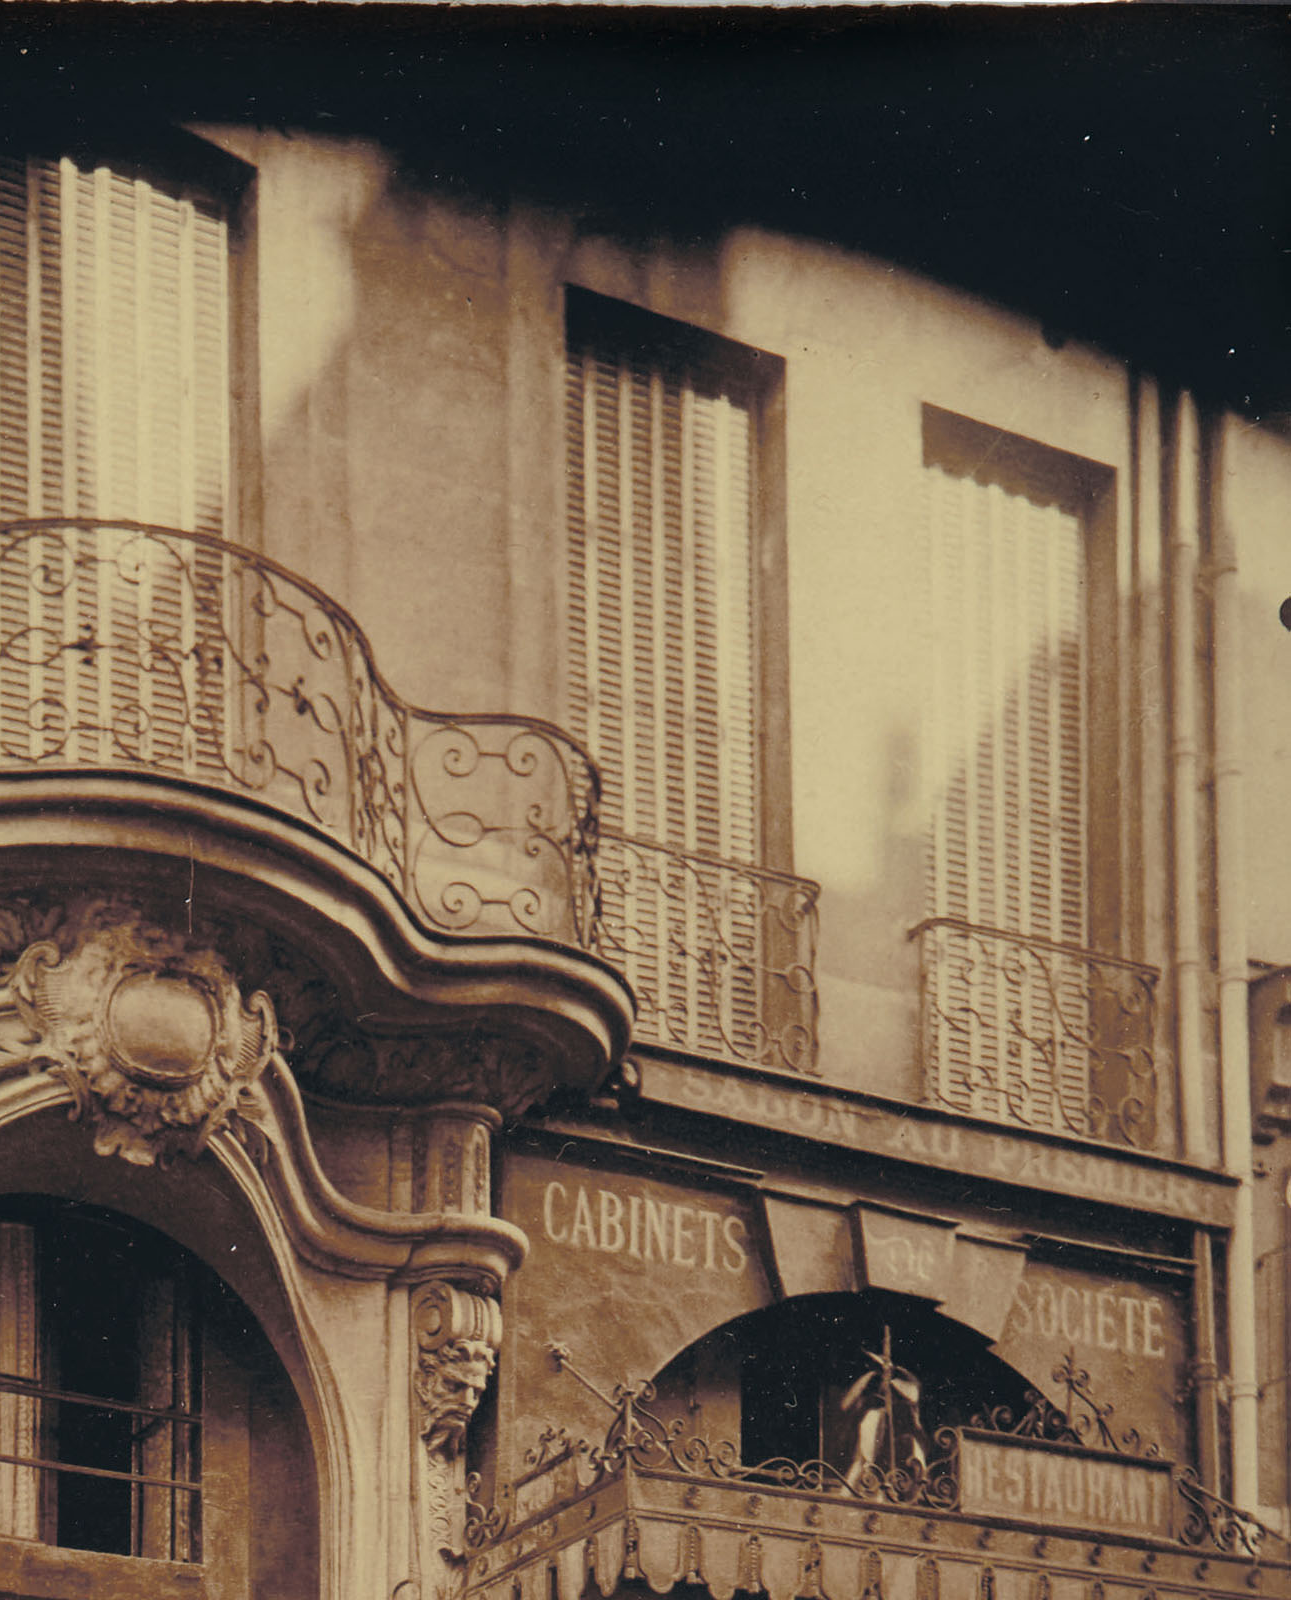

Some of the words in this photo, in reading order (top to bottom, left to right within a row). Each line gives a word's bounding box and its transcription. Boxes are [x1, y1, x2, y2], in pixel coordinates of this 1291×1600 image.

[682, 1074, 860, 1144] SALON
[886, 1117, 961, 1160] AU
[989, 1135, 1200, 1214] PREMIER
[543, 1180, 747, 1275] CABINETS
[1009, 1277, 1167, 1360] SOCIÉTÉ
[964, 1444, 1164, 1528] RESTAURANT
